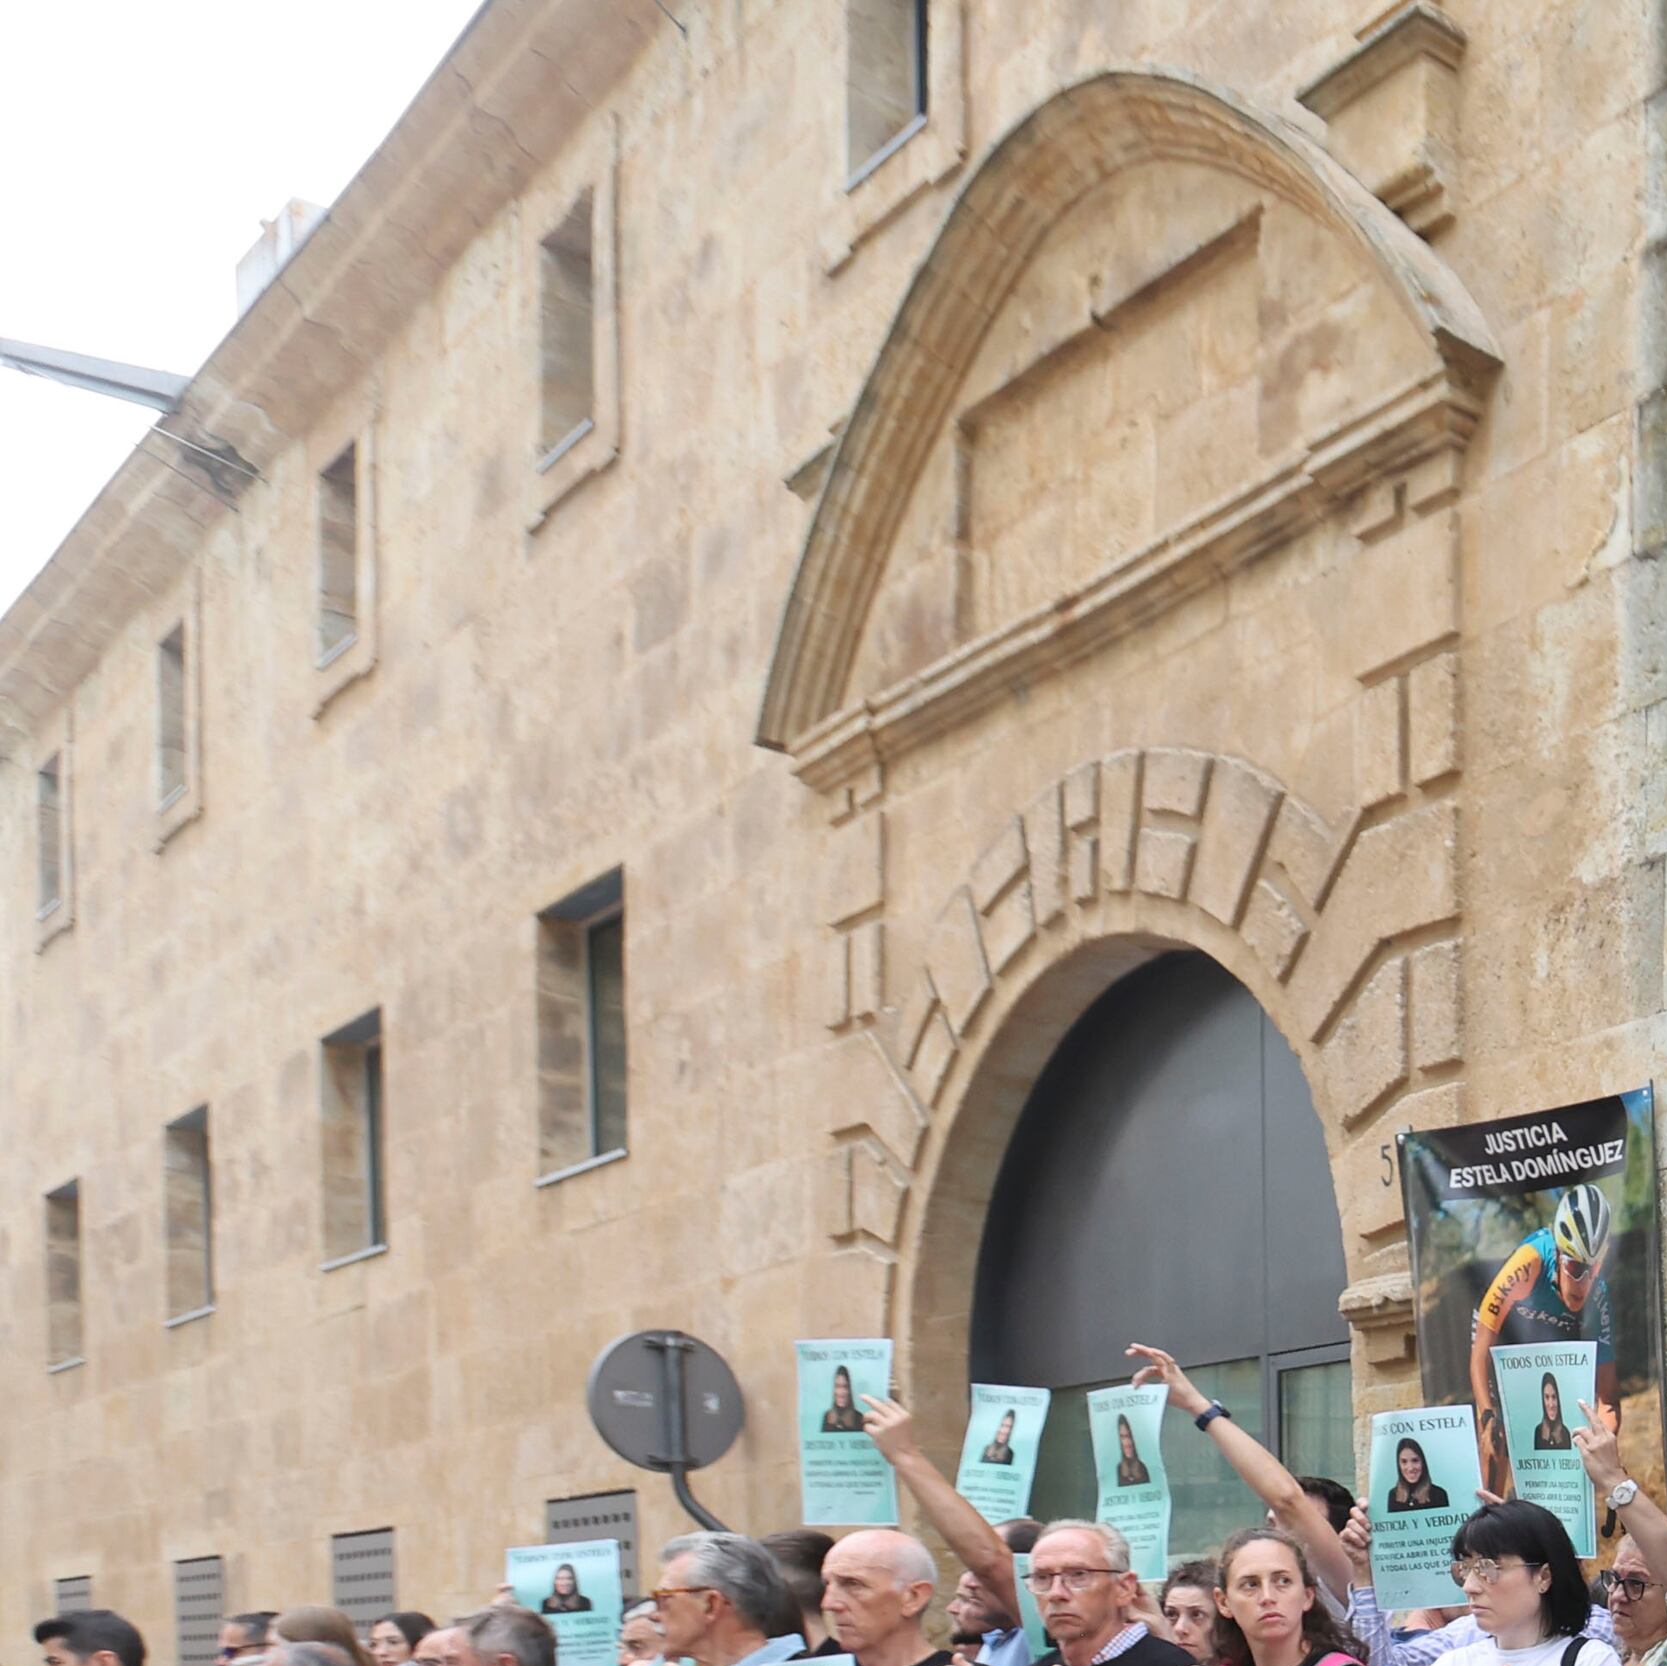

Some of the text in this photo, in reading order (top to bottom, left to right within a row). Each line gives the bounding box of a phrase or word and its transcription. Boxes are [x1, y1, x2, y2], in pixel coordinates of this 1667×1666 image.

[1484, 1122, 1568, 1155] JUSTICIA
[1450, 1139, 1624, 1189] ESTELA DOMÍNGUEZ
[1500, 1354, 1588, 1369] TODOS CON ESTELA
[1390, 1422, 1414, 1434] CON
[1420, 1417, 1467, 1432] ESTELA
[1413, 1513, 1470, 1529] Y VERDAD
